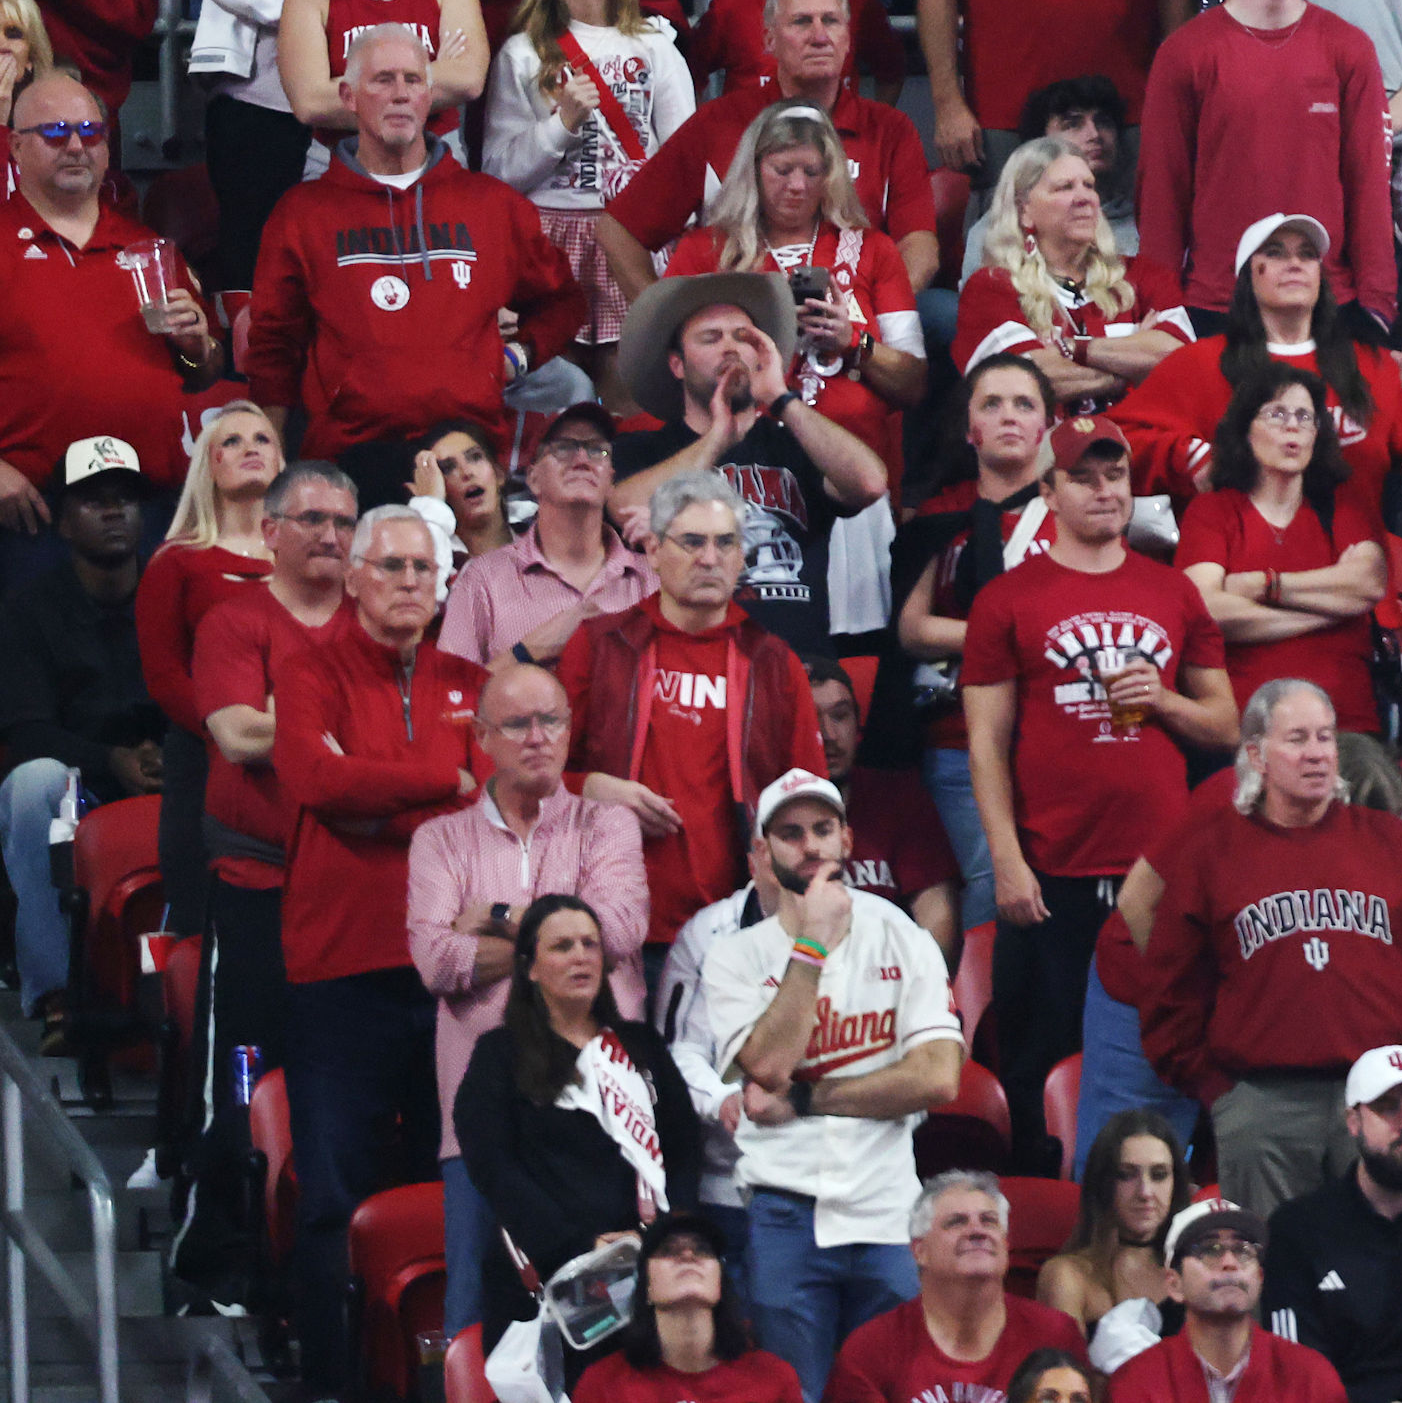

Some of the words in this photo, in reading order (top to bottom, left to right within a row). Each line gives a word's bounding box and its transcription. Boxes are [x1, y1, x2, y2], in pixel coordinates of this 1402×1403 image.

[335, 222, 473, 258] INDIANA
[1044, 622, 1173, 671] INDIANA
[1233, 888, 1393, 958] INDIANA
[808, 996, 897, 1060] diana
